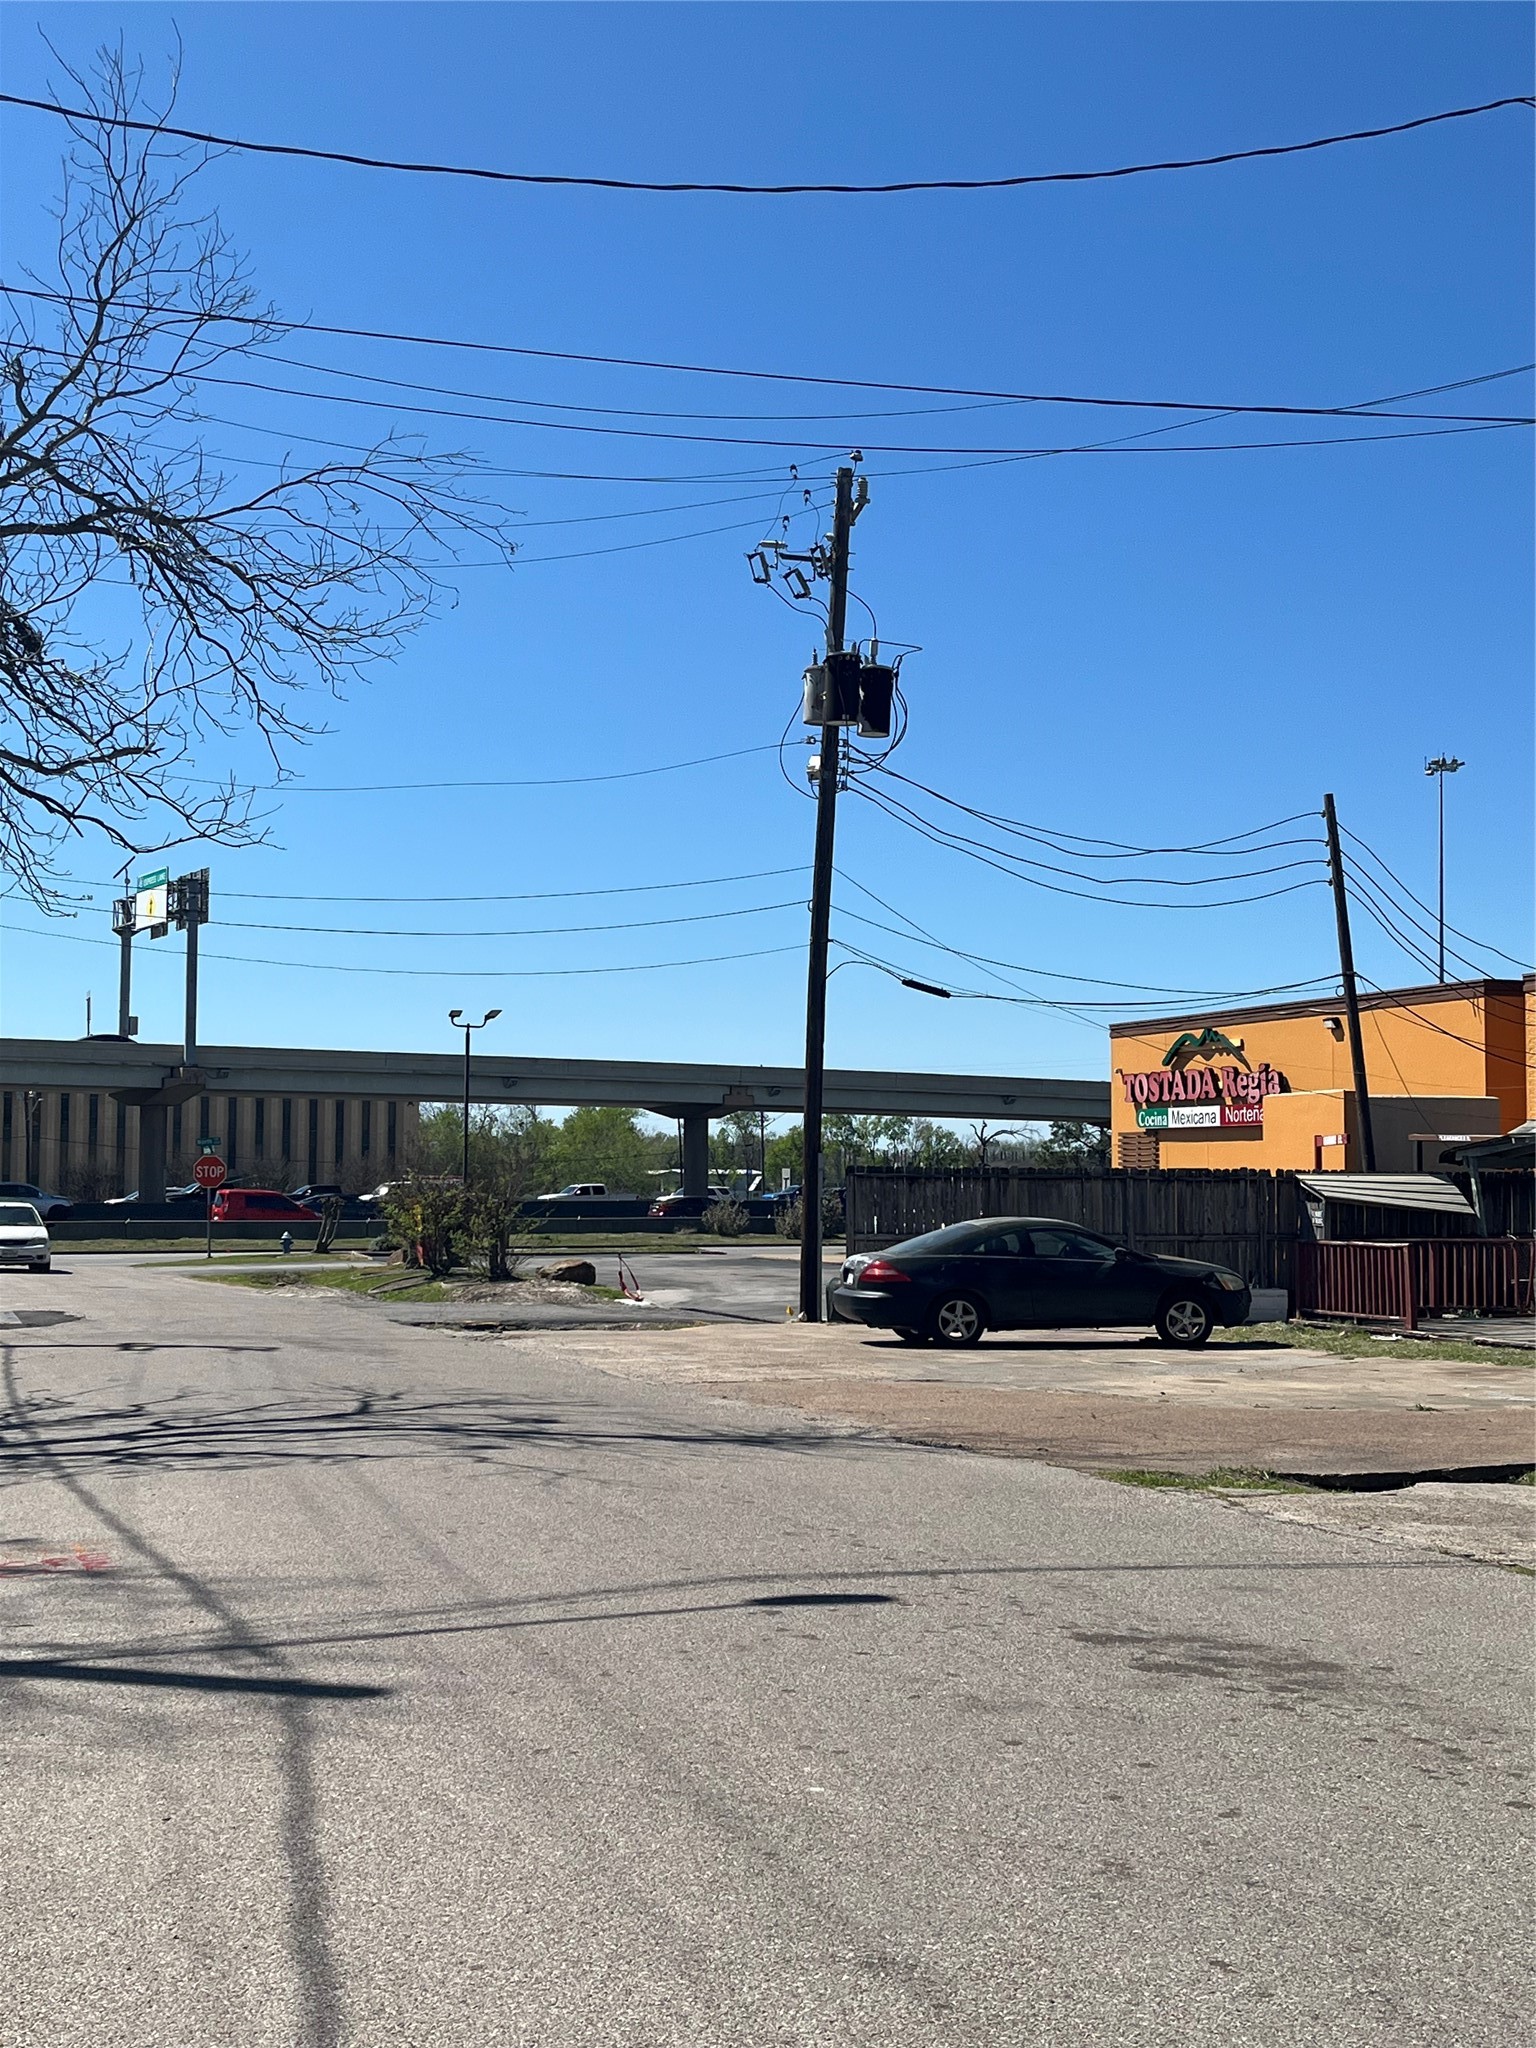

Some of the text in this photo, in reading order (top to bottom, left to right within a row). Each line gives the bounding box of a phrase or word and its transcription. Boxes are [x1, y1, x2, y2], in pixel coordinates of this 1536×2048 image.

[1124, 1067, 1217, 1103] TOSTADA
[1138, 1111, 1167, 1127] Cocina
[1171, 1109, 1217, 1126] Mexicana
[196, 1166, 224, 1178] STOP
